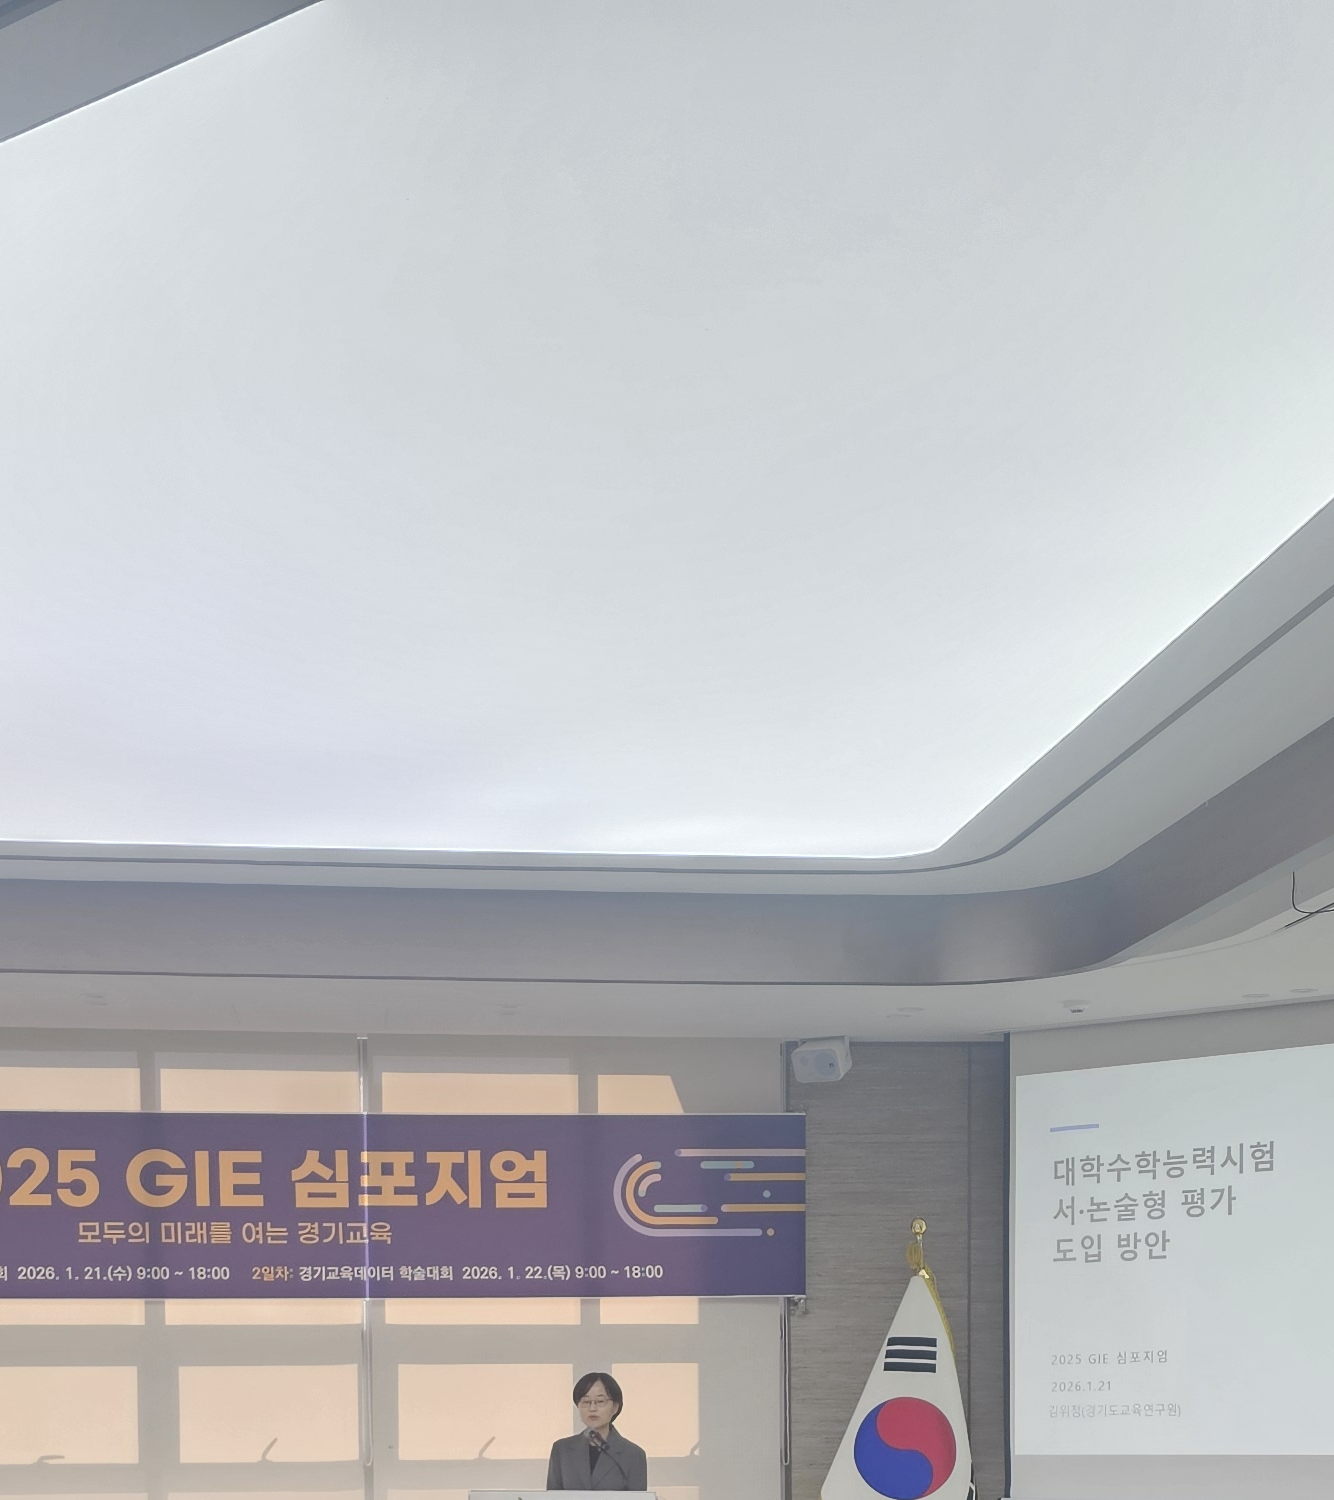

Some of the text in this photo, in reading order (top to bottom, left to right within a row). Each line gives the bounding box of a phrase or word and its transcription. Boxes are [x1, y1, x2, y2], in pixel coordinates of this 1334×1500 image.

[1052, 1140, 1276, 1187] 대학수학능력시험
[125, 1148, 264, 1208] GIE
[291, 1149, 548, 1209] 심포지엄
[1052, 1185, 1237, 1226] 서·논술형 평가
[77, 1221, 393, 1245] 모두의 미래를 여는 경기교육
[1052, 1229, 1171, 1264] 도입 방안
[137, 1266, 170, 1281] 9:00
[188, 1266, 230, 1281] 18:00
[251, 1265, 294, 1282] 2일차:
[298, 1265, 395, 1282] 경기교육데이터
[399, 1265, 454, 1282] 학술대회
[575, 1265, 607, 1281] 9:00
[624, 1265, 664, 1281] 18:00
[1051, 1349, 1168, 1365] 2025 GIE 심포지엄
[1051, 1380, 1112, 1392] 2026.1.21
